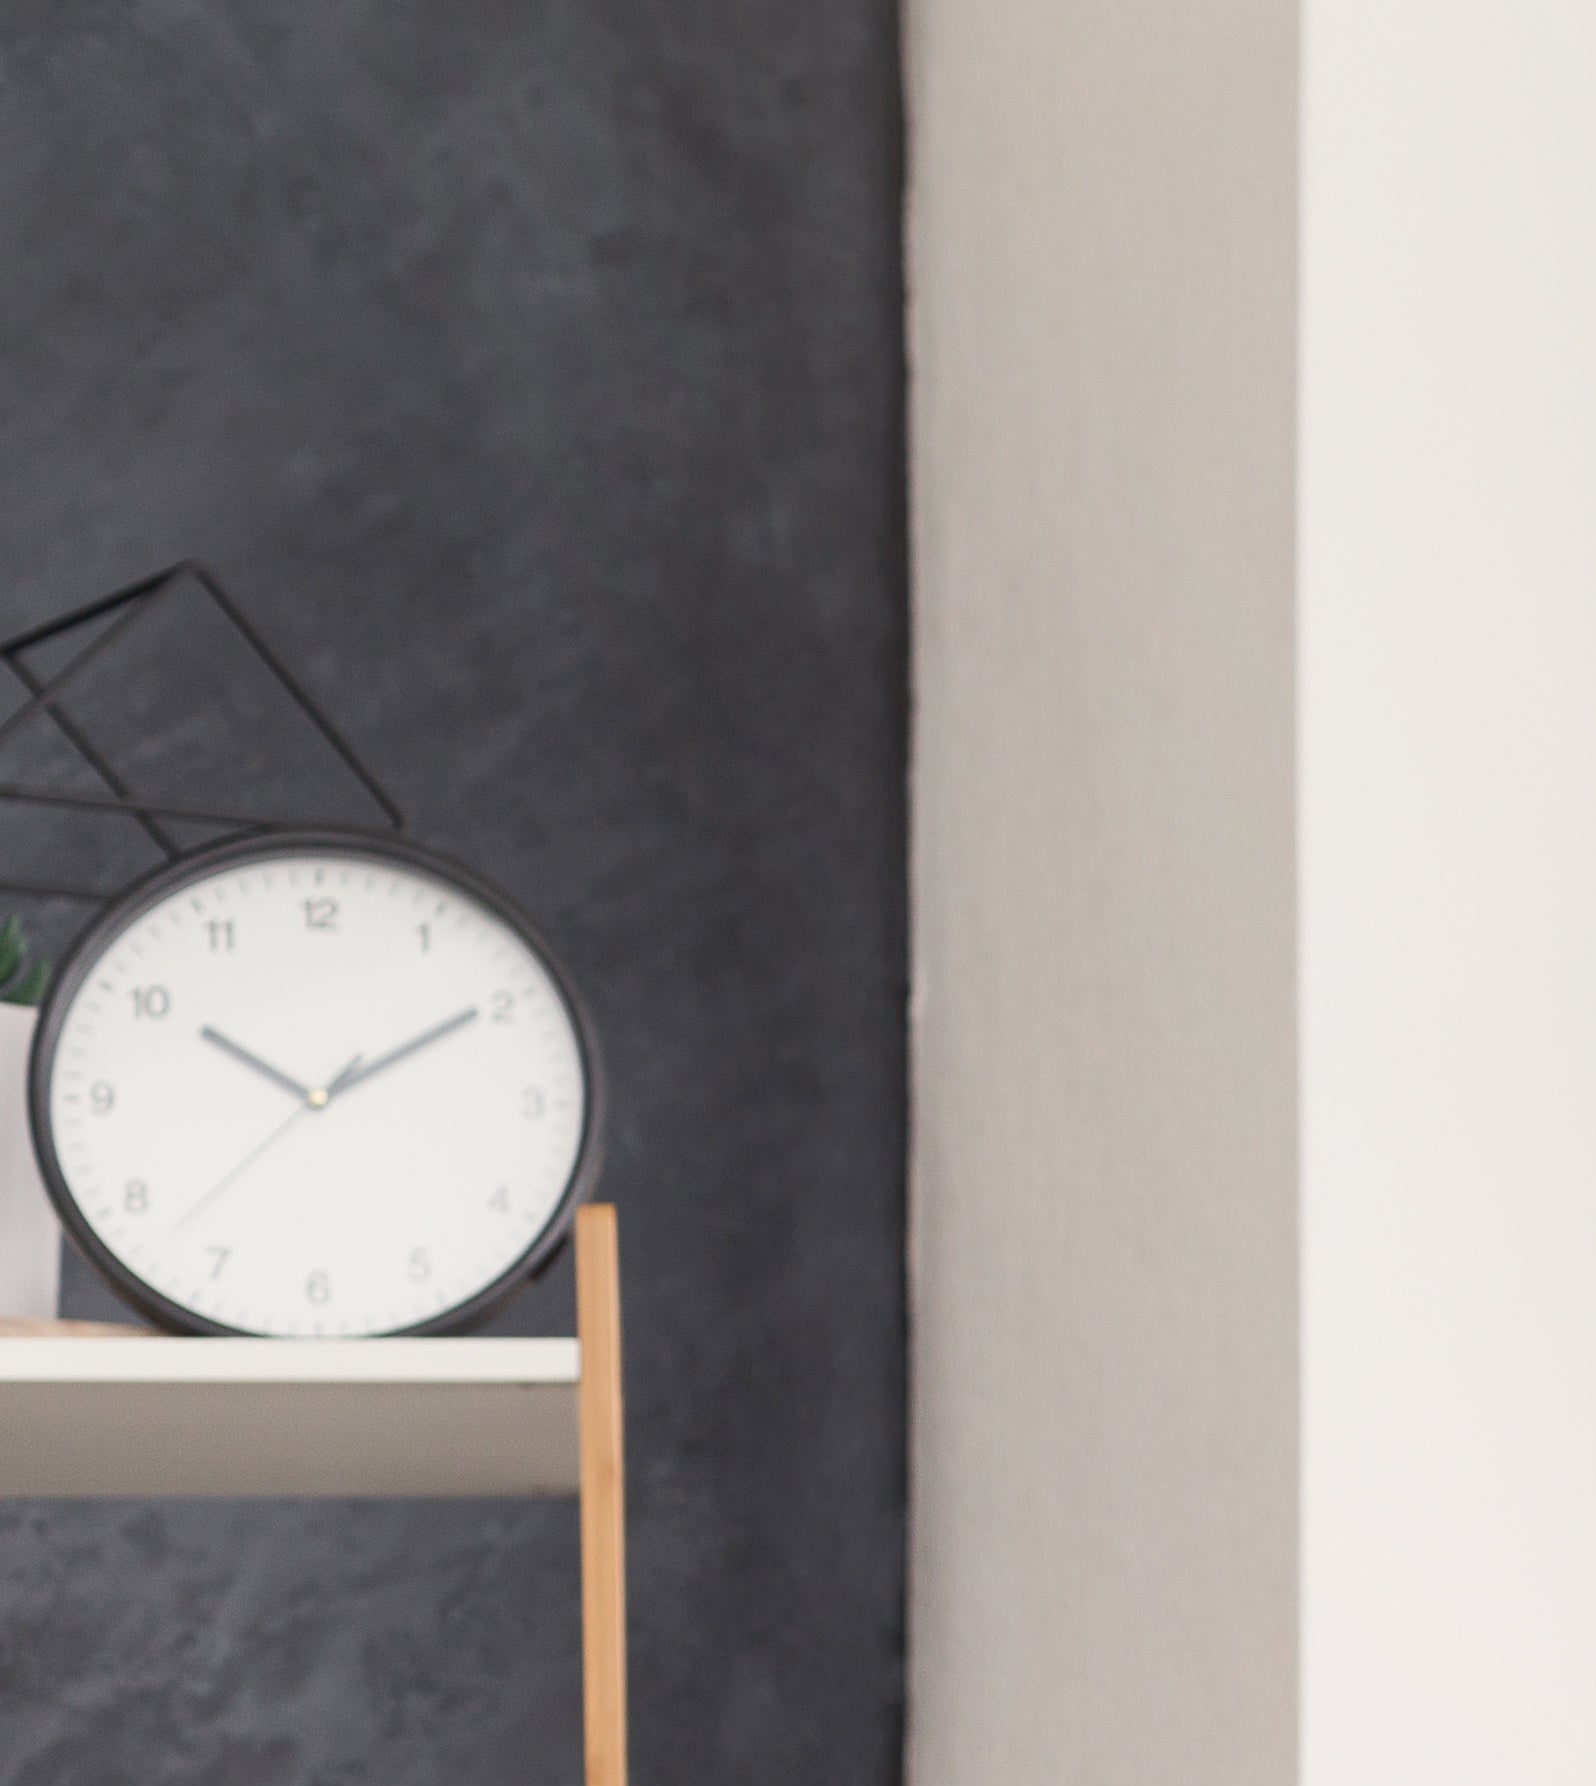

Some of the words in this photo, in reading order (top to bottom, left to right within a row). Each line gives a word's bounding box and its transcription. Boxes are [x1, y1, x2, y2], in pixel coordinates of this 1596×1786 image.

[302, 897, 339, 932] 12
[205, 919, 235, 950] 11
[415, 922, 432, 952] 1
[130, 984, 170, 1020] 10
[490, 989, 516, 1024] 2
[89, 1080, 116, 1115] 9
[521, 1085, 548, 1120] 3
[123, 1179, 150, 1215] 8
[487, 1183, 512, 1216] 4
[206, 1246, 232, 1281] 7
[408, 1247, 433, 1283] 5
[304, 1270, 332, 1306] 6
